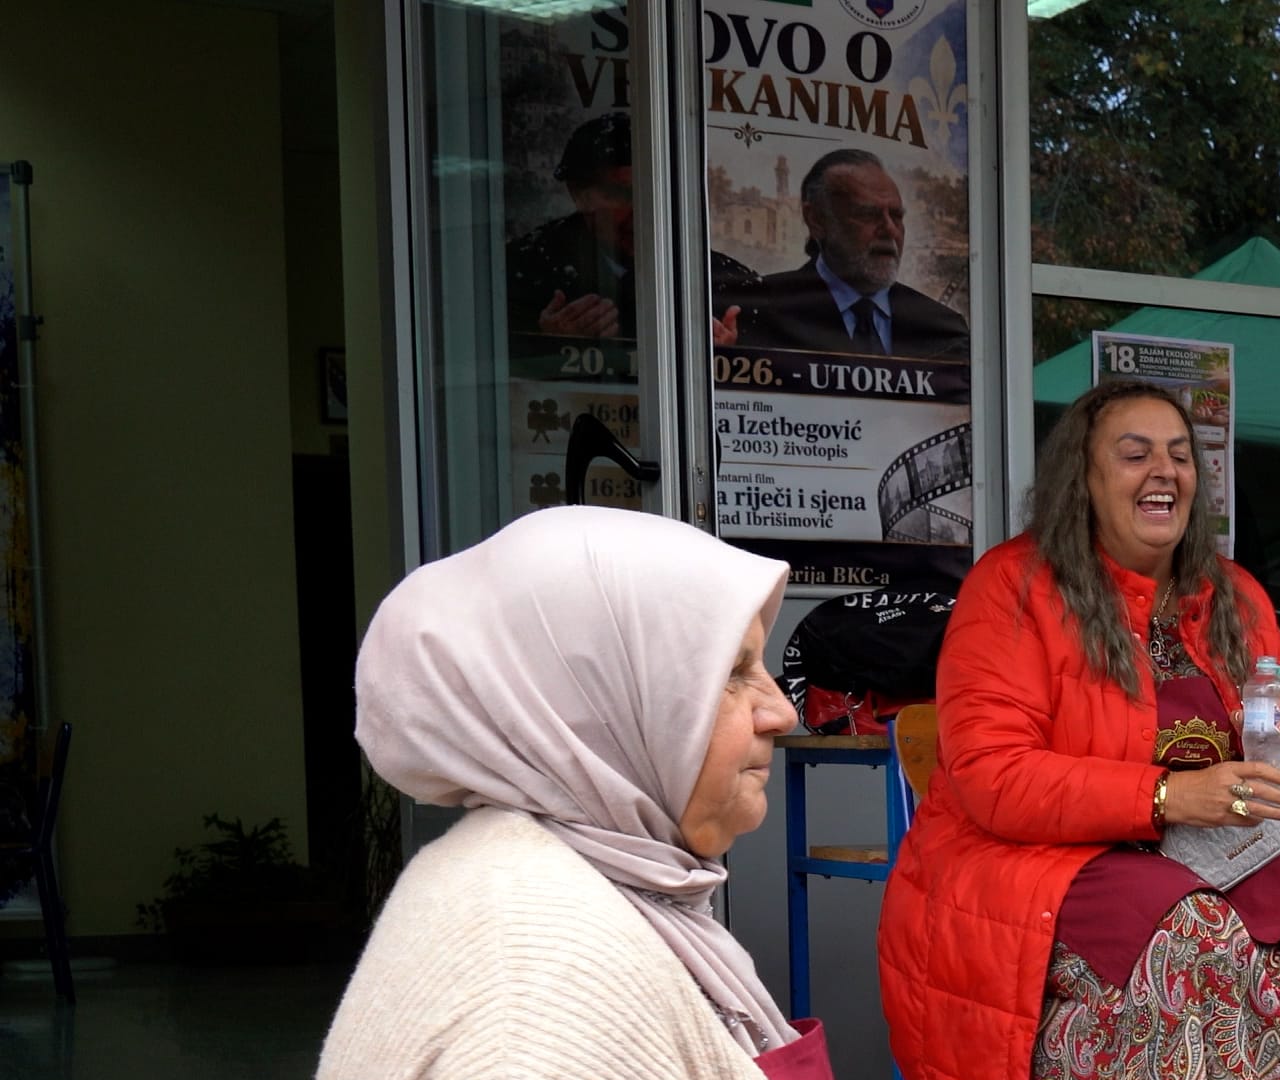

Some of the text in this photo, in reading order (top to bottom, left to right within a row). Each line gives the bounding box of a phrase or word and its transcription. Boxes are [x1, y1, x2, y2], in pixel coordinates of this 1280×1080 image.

[846, 31, 892, 83] O
[1104, 345, 1140, 374] 18.
[1138, 347, 1165, 356] SAJAM
[1138, 355, 1168, 366] ZDRAVE
[560, 346, 614, 375] 20.
[714, 355, 784, 387] 026.
[809, 363, 936, 396] UTORAK
[587, 403, 640, 423] 16:0
[752, 401, 774, 414] film
[737, 414, 862, 443] Izetbegović
[783, 441, 849, 461] životopis
[754, 474, 775, 486] film
[735, 486, 792, 511] riječi
[798, 489, 806, 508] i
[810, 489, 867, 512] sjena
[746, 511, 834, 529] Ibrišimović
[786, 567, 890, 585] erija BKC-a
